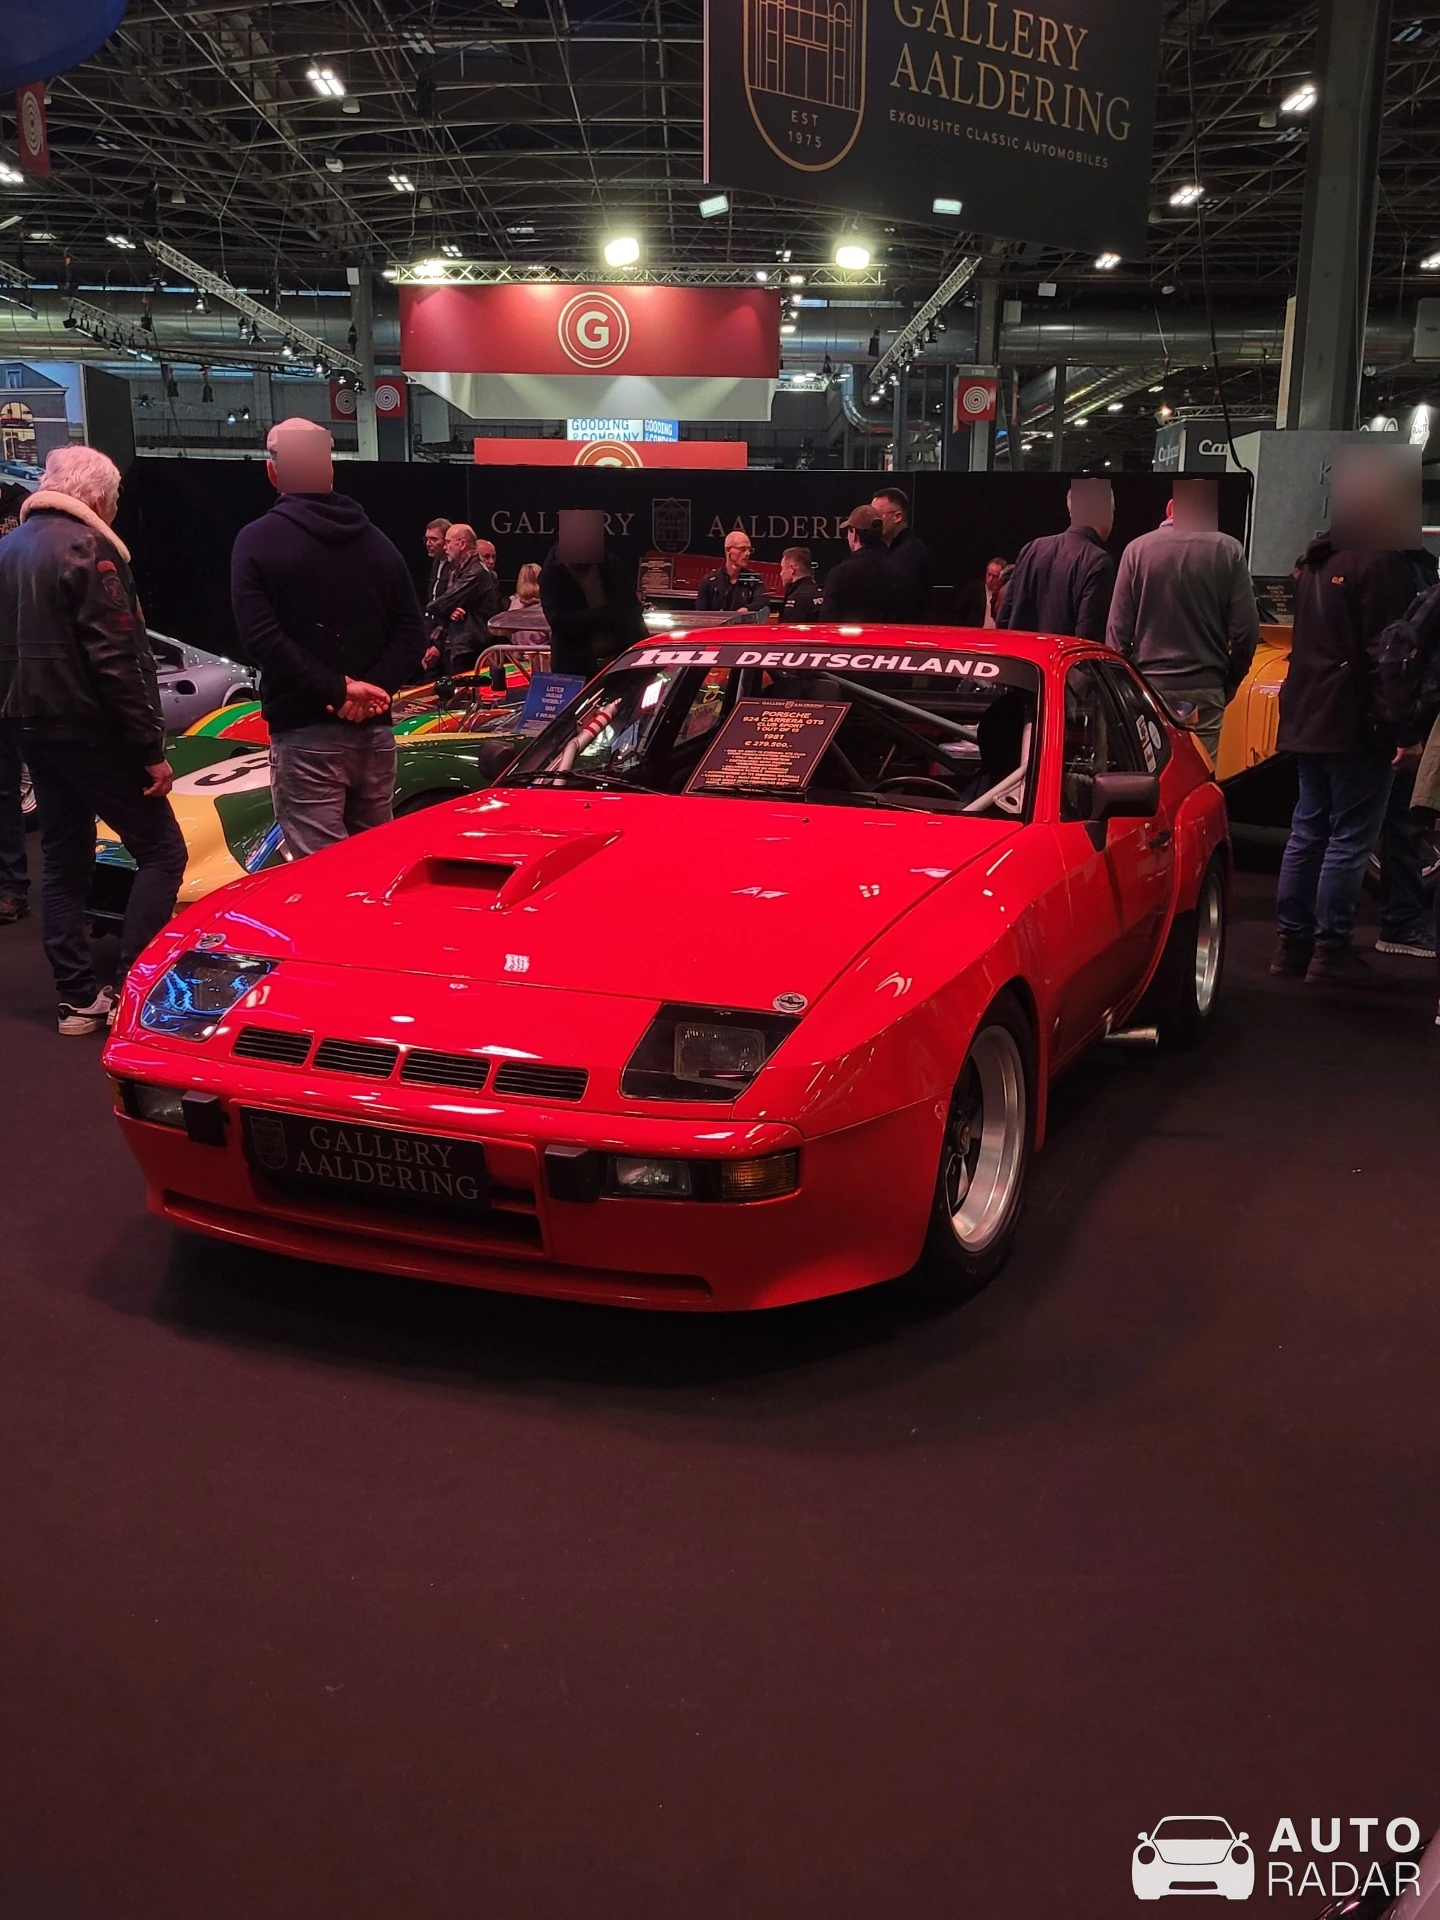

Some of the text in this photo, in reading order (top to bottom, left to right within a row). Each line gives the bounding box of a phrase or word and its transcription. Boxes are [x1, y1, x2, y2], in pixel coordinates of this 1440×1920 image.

[892, 0, 1088, 71] GALLERY
[890, 42, 1130, 141] AALDERING
[788, 130, 822, 148] 1975
[889, 109, 1109, 168] EXQUISITE CLASSIC AUTOMOBILES
[576, 311, 609, 349] G
[571, 419, 629, 431] GOODING
[645, 420, 672, 435] GOODING
[490, 511, 850, 539] GALRY AALDERI
[735, 651, 1001, 678] DEUTSCHLAND
[309, 1125, 453, 1168] GALLERY
[296, 1150, 479, 1200] AALDERING
